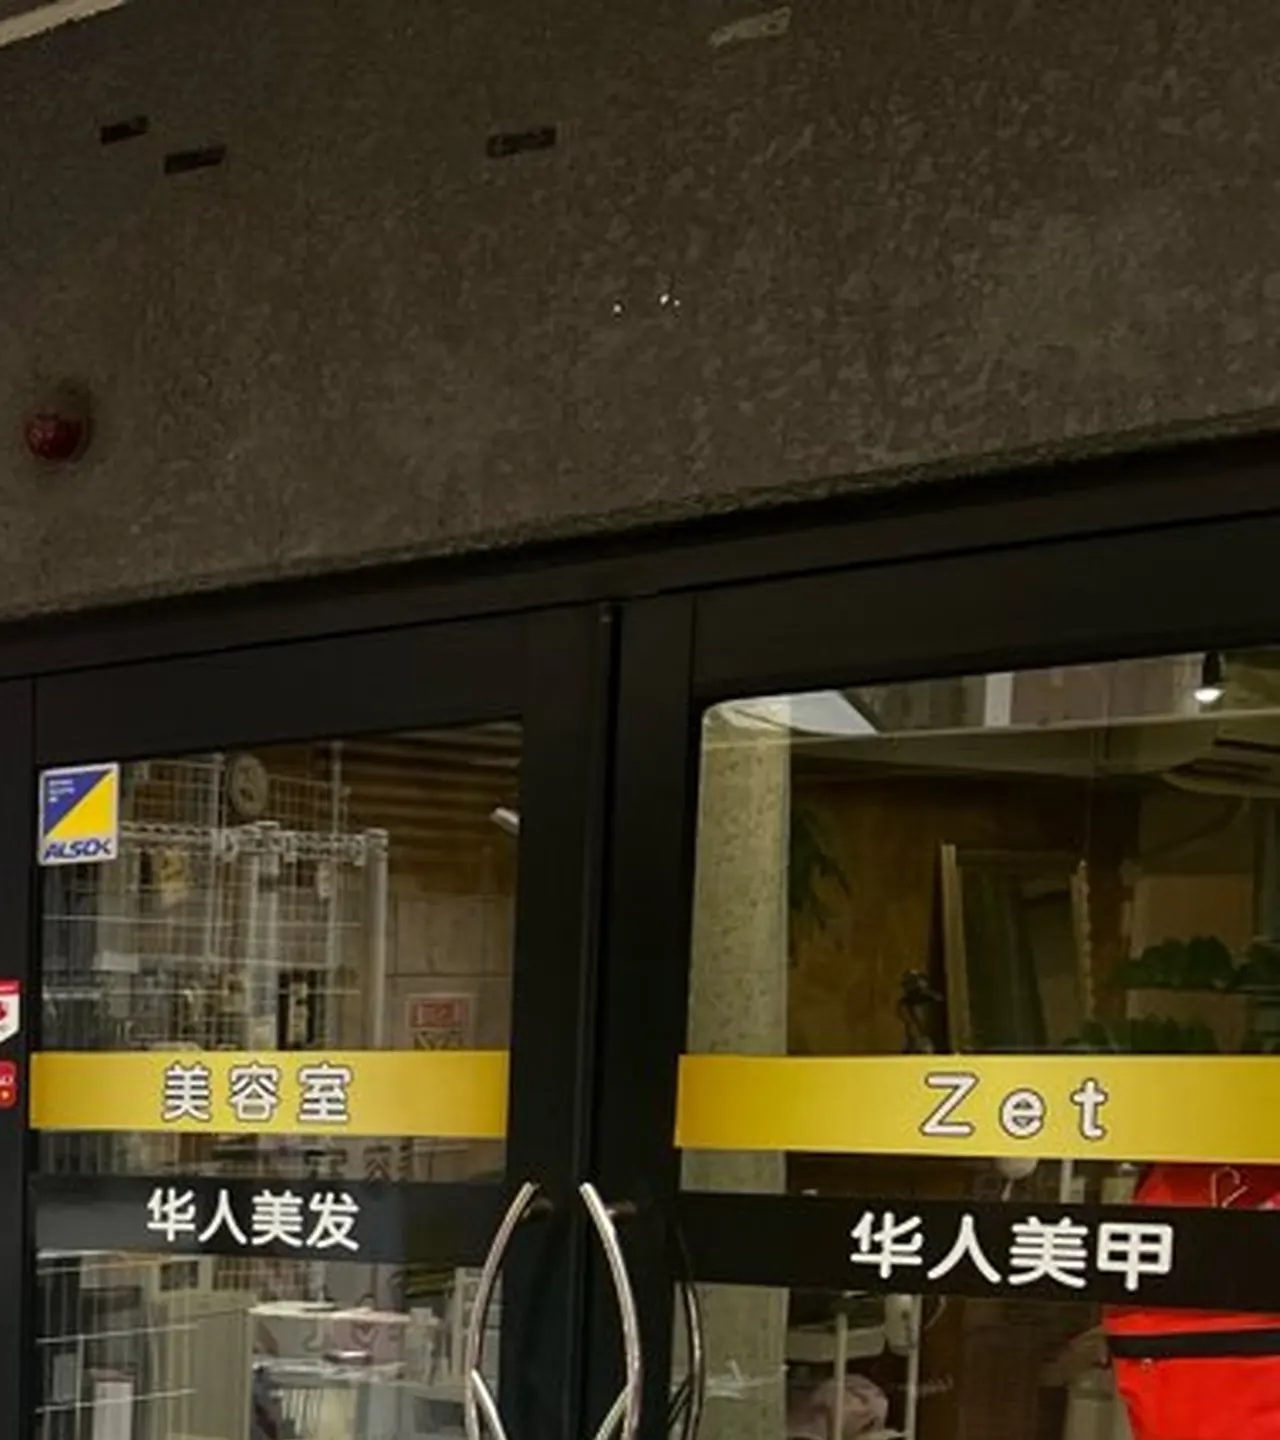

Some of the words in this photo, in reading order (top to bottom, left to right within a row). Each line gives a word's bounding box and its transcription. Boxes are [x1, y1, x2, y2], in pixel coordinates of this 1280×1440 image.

[44, 838, 112, 860] ALSOK
[162, 1061, 354, 1123] 美容室
[919, 1072, 1108, 1139] Zet
[146, 1187, 360, 1252] 华人美发
[850, 1211, 1174, 1290] 华人美甲
